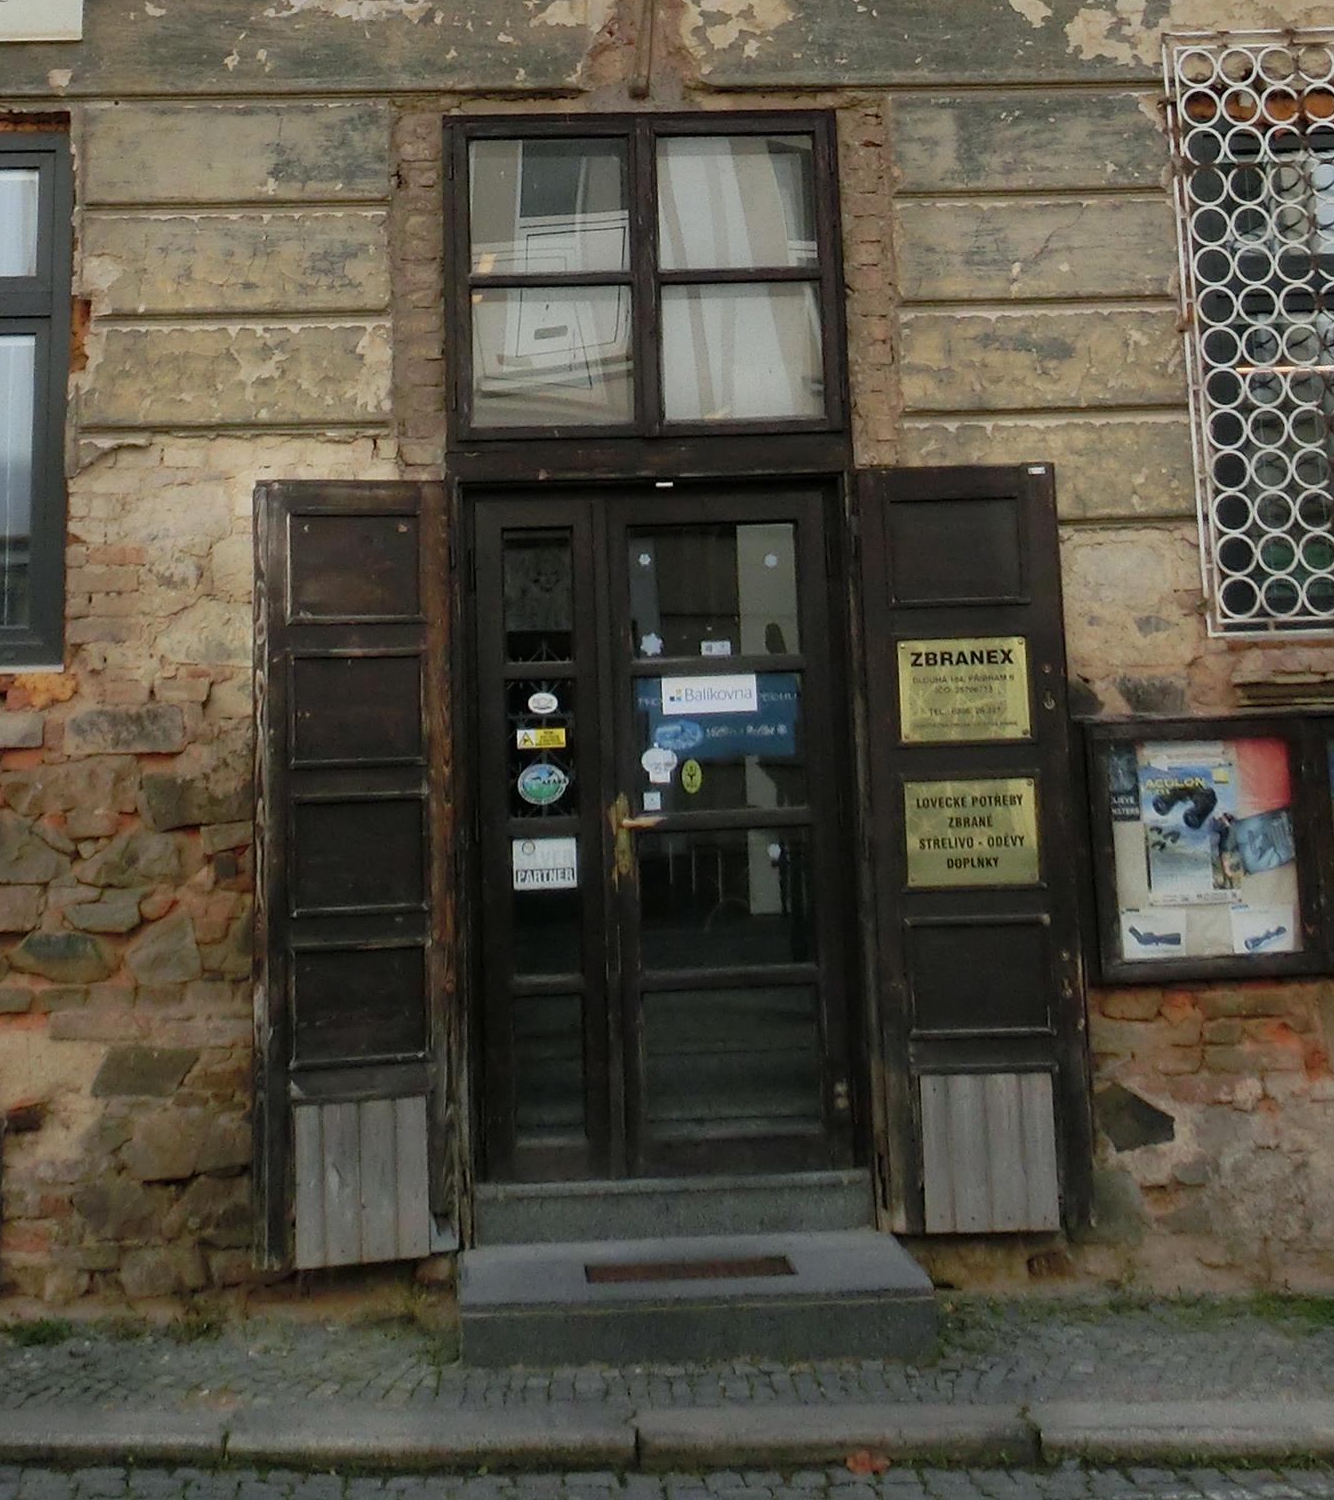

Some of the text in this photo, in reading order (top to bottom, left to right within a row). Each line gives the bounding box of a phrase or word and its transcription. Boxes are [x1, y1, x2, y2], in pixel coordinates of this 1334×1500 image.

[910, 648, 1014, 668] ZBRANEX
[684, 686, 753, 702] Balíkovna
[515, 867, 576, 884] PARTNER
